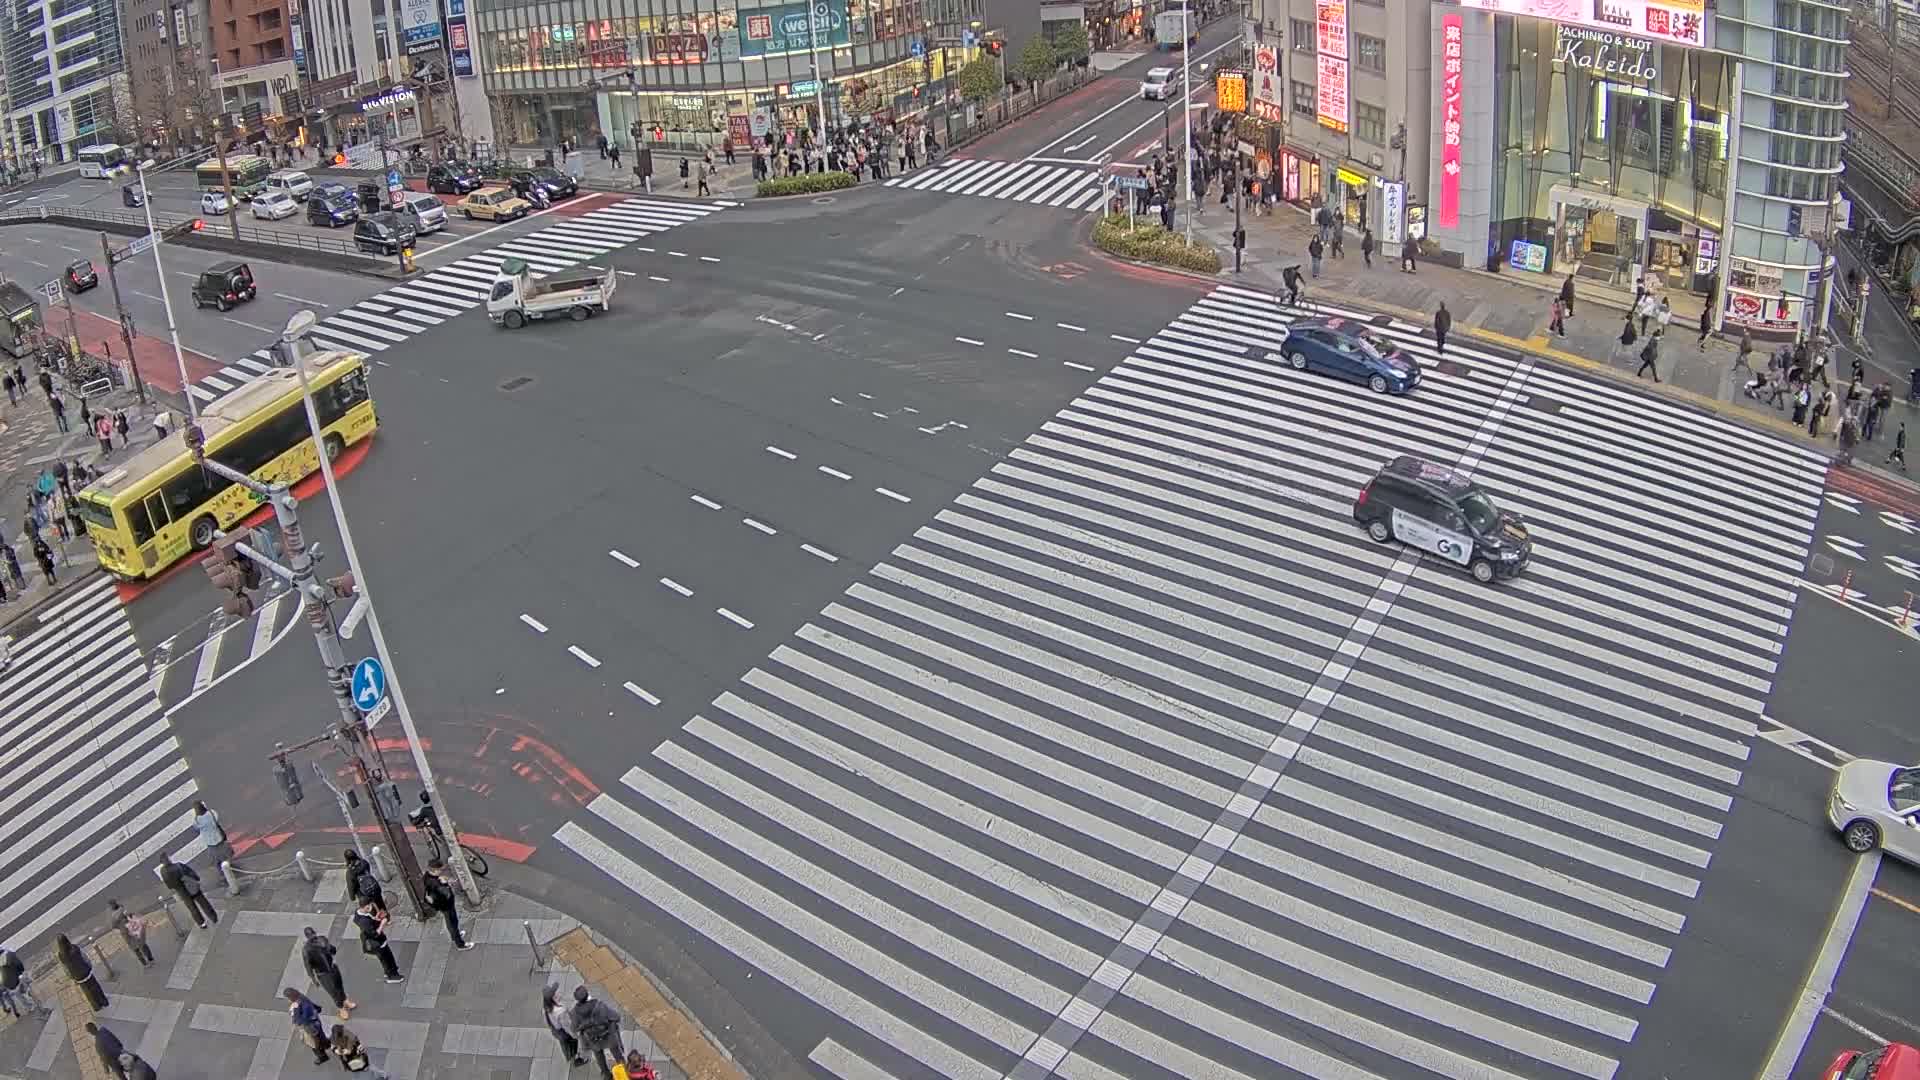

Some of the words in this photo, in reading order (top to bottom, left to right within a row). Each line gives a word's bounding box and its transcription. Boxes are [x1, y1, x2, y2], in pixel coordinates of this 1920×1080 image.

[1557, 25, 1613, 44] PACHINKO
[1615, 35, 1622, 46] &
[1625, 37, 1652, 52] SLOT
[1554, 39, 1656, 80] Kaleido
[1437, 539, 1463, 560] GO
